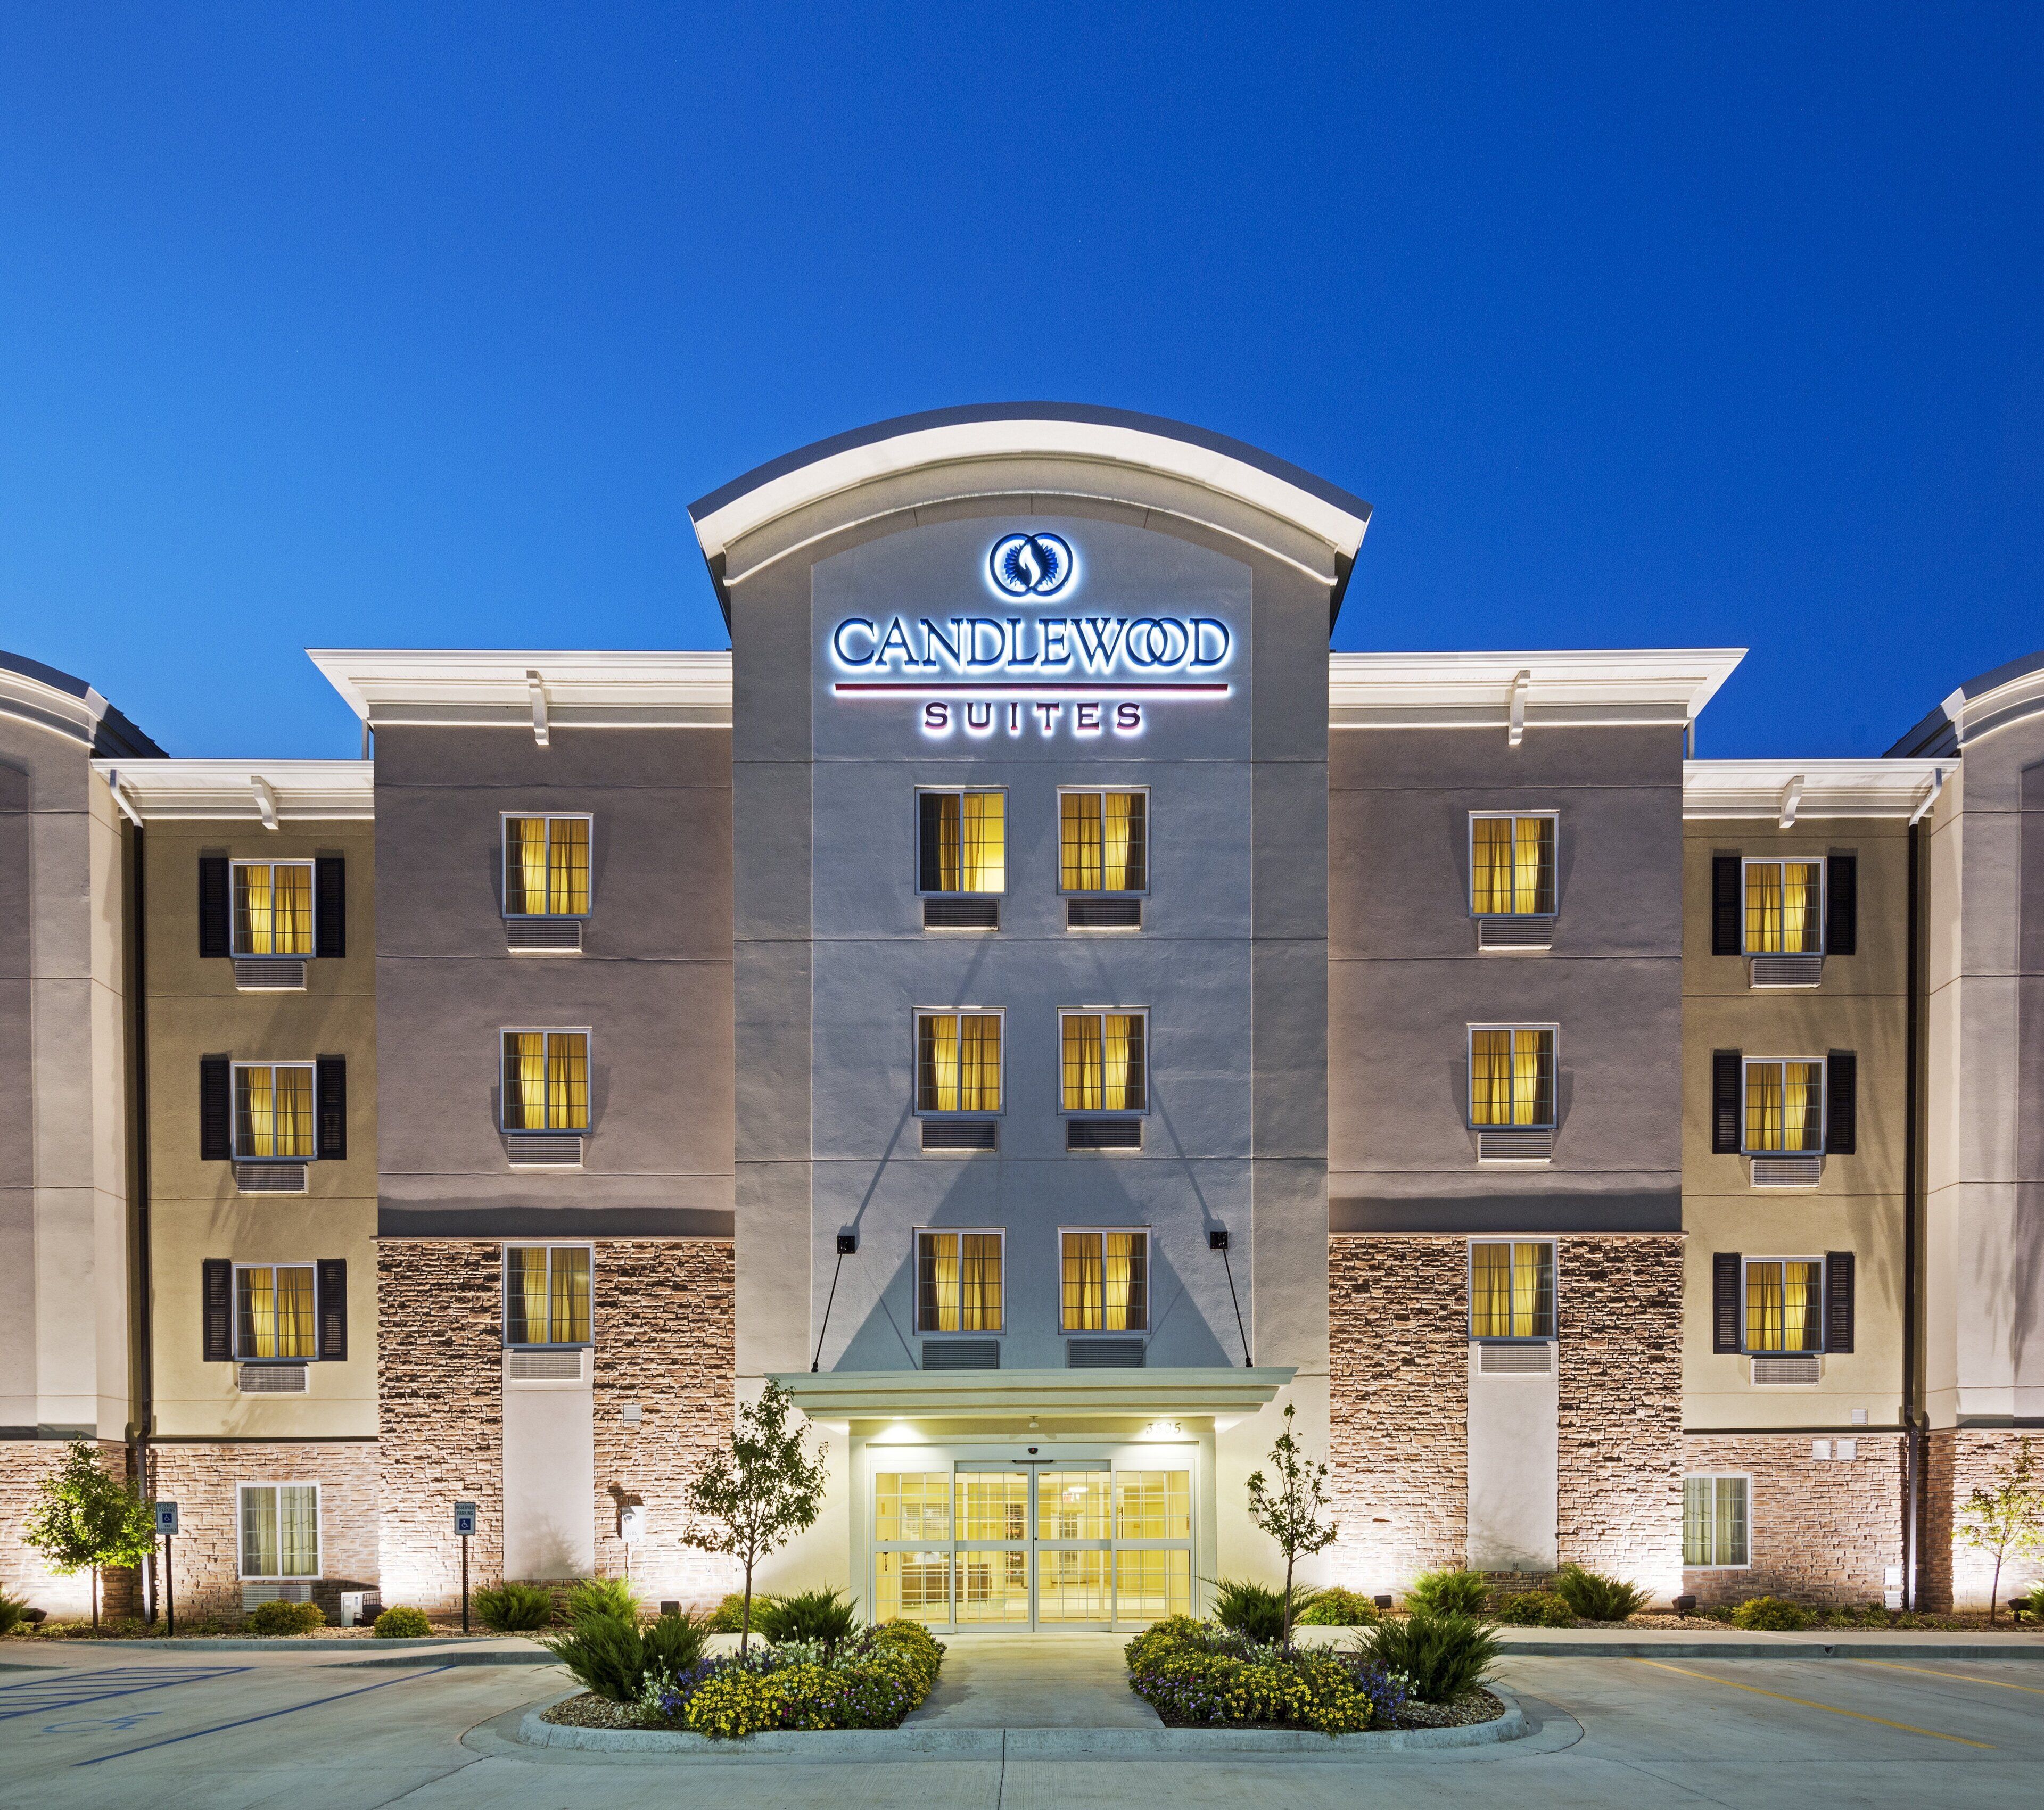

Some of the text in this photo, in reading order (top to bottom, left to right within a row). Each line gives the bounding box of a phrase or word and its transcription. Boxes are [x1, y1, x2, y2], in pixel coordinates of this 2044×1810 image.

[834, 616, 1230, 667] CANDLEWOOD
[925, 702, 1140, 731] SUITES
[1146, 1422, 1181, 1434] 3505
